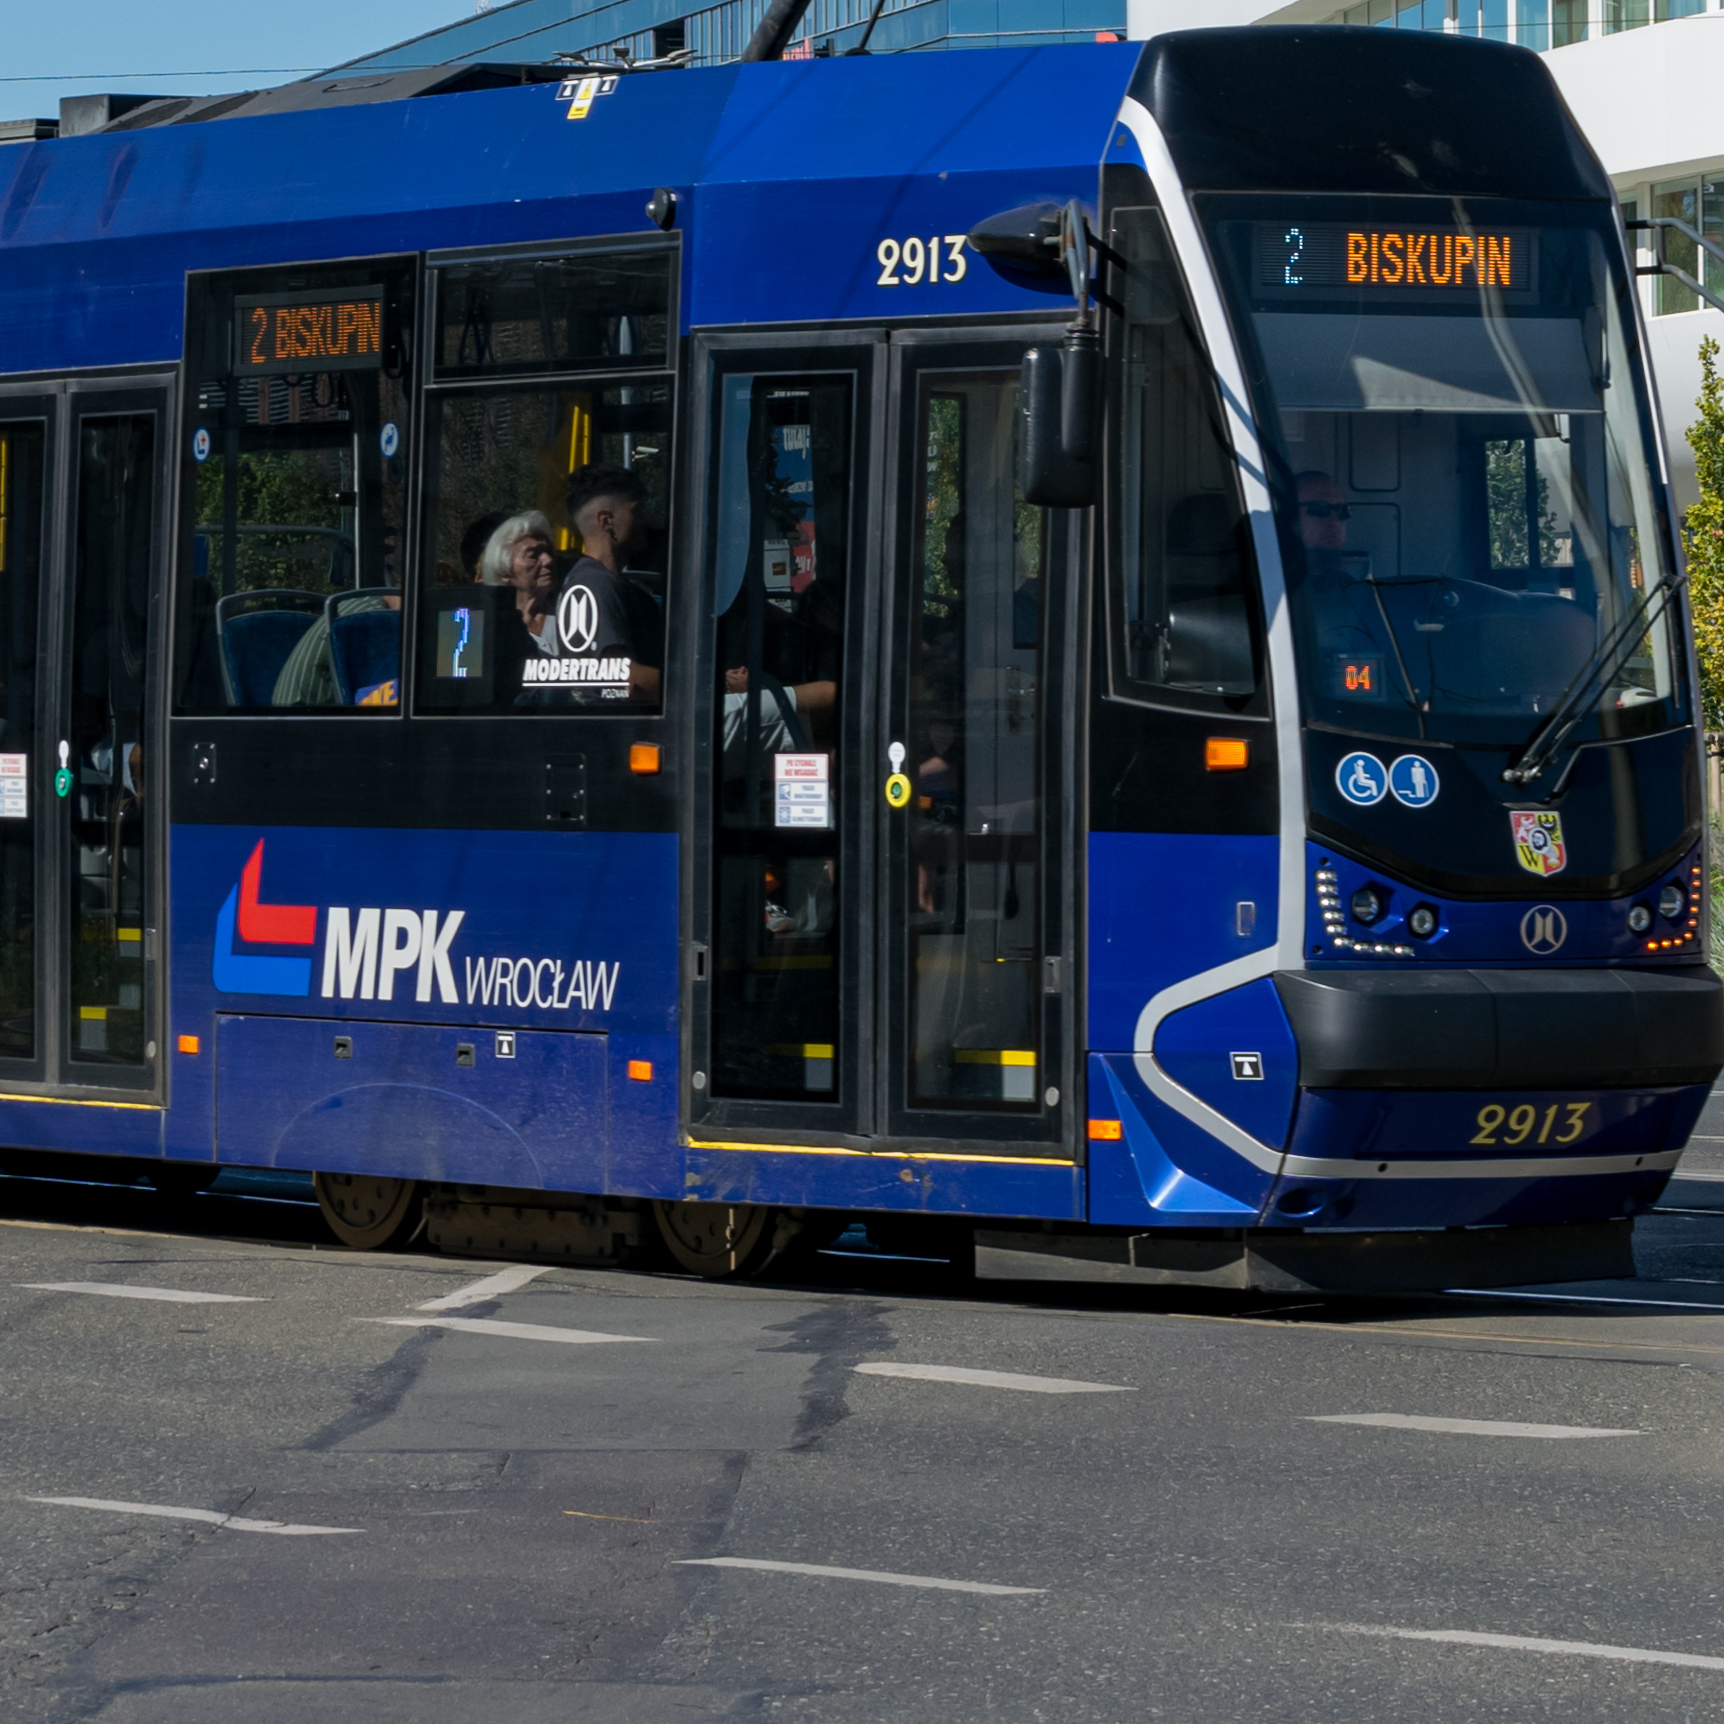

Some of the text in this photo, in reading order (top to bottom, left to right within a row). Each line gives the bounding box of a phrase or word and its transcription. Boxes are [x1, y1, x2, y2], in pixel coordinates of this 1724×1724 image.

[875, 233, 968, 288] 2913
[1283, 227, 1512, 286] 2 BISKUPIN
[249, 302, 381, 364] 2 BISKUPIN
[452, 607, 471, 678] 2
[522, 656, 632, 681] MODERTRANS
[1344, 664, 1371, 691] 04
[320, 906, 620, 1011] MPK WROCŁAW
[1468, 1101, 1593, 1146] 2913
